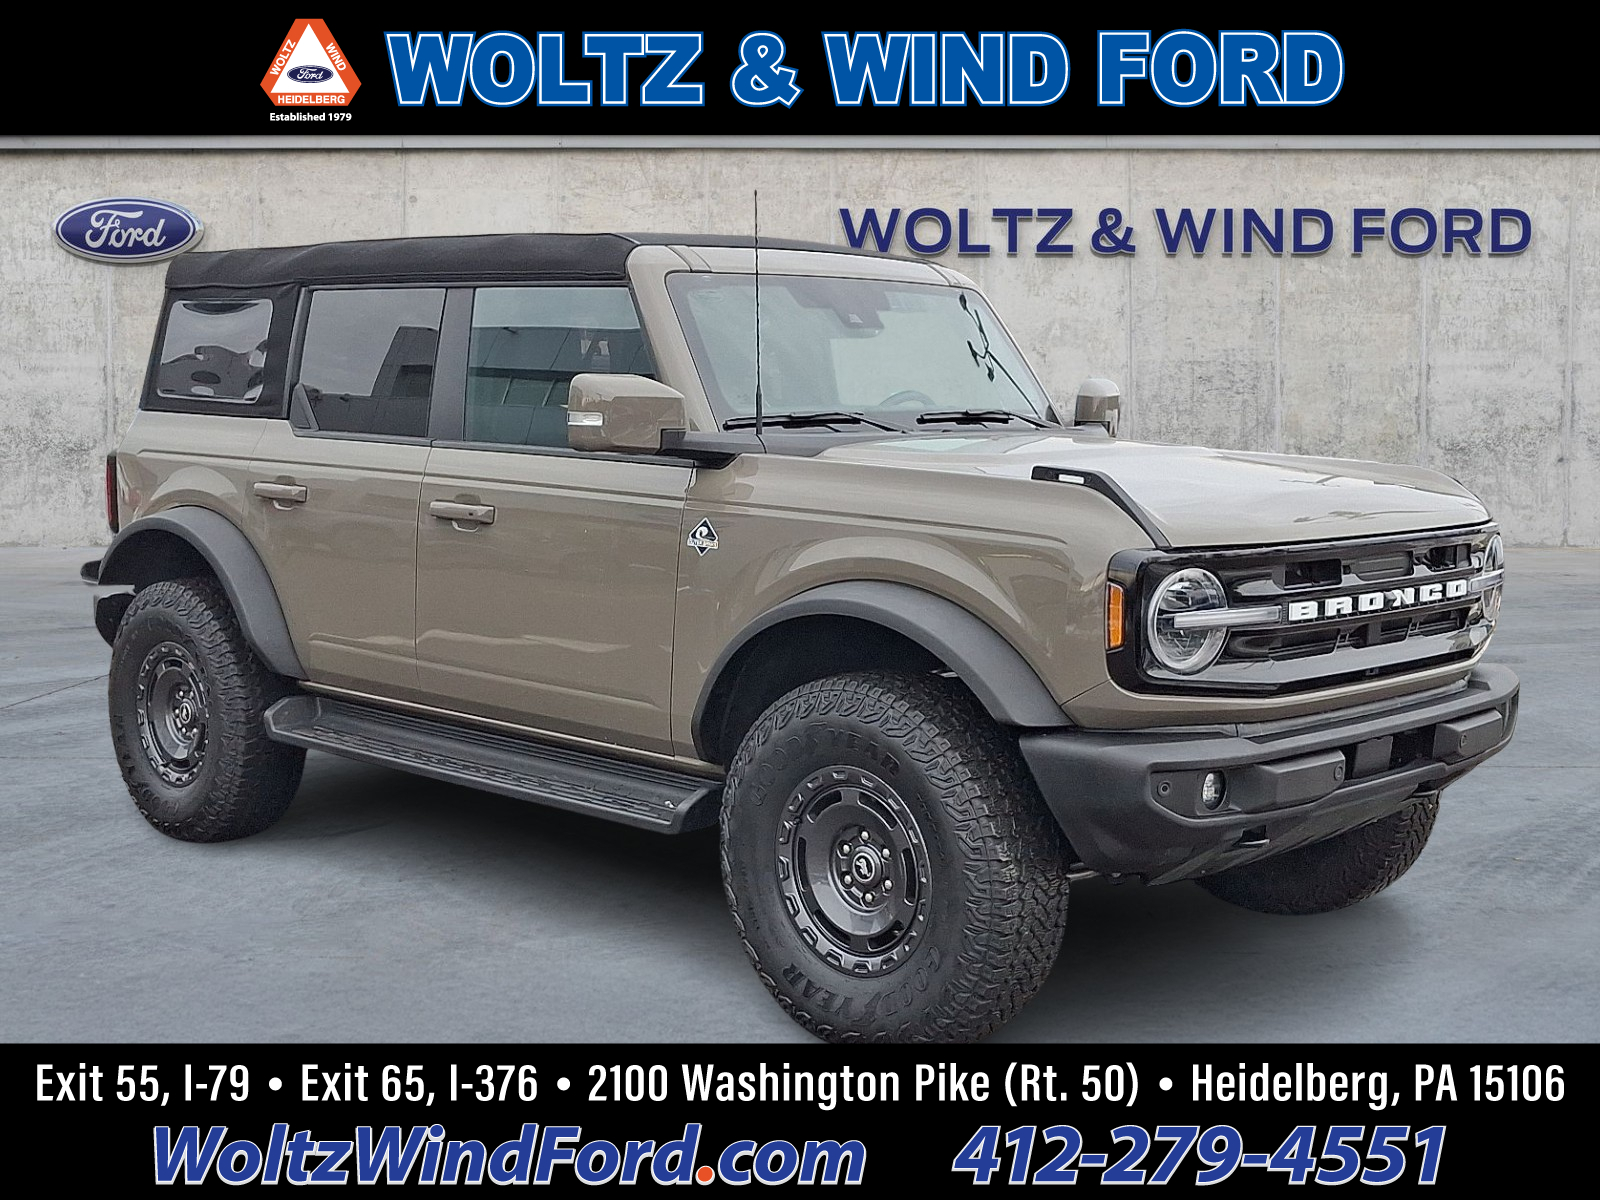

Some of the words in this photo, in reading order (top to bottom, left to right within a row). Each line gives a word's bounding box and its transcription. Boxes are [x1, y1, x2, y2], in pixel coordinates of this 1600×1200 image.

[84, 208, 167, 249] Ford
[838, 207, 1075, 255] WOLTZ
[1091, 207, 1137, 256] &
[1155, 207, 1334, 256] WIND
[1352, 207, 1533, 256] FORD
[1287, 578, 1469, 622] BRONCO
